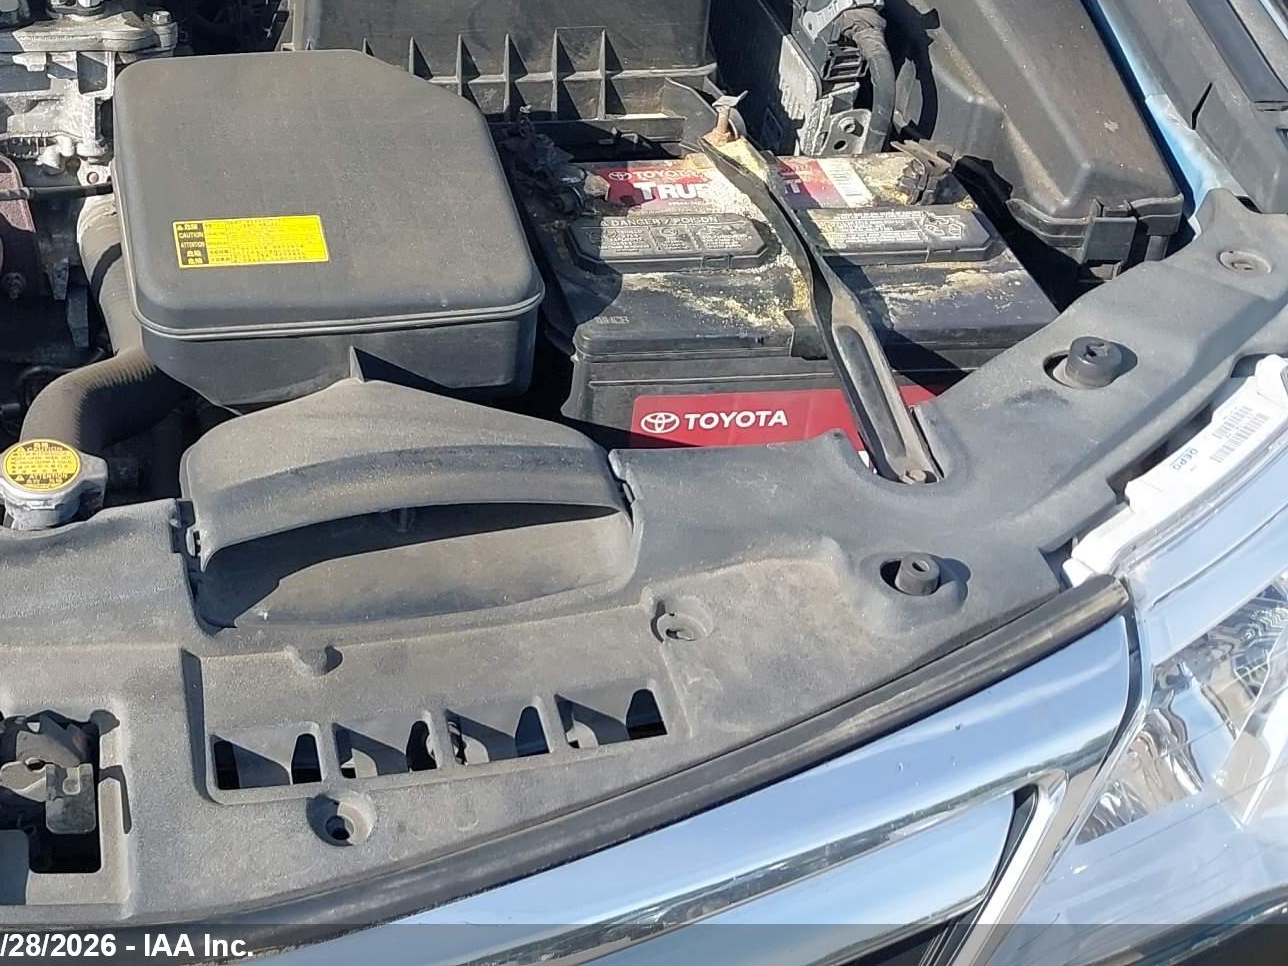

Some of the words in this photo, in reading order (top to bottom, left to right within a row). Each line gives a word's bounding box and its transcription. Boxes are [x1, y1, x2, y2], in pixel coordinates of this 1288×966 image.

[611, 218, 662, 227] DANGER
[672, 216, 719, 226] POISON
[684, 410, 788, 430] TOYOTA
